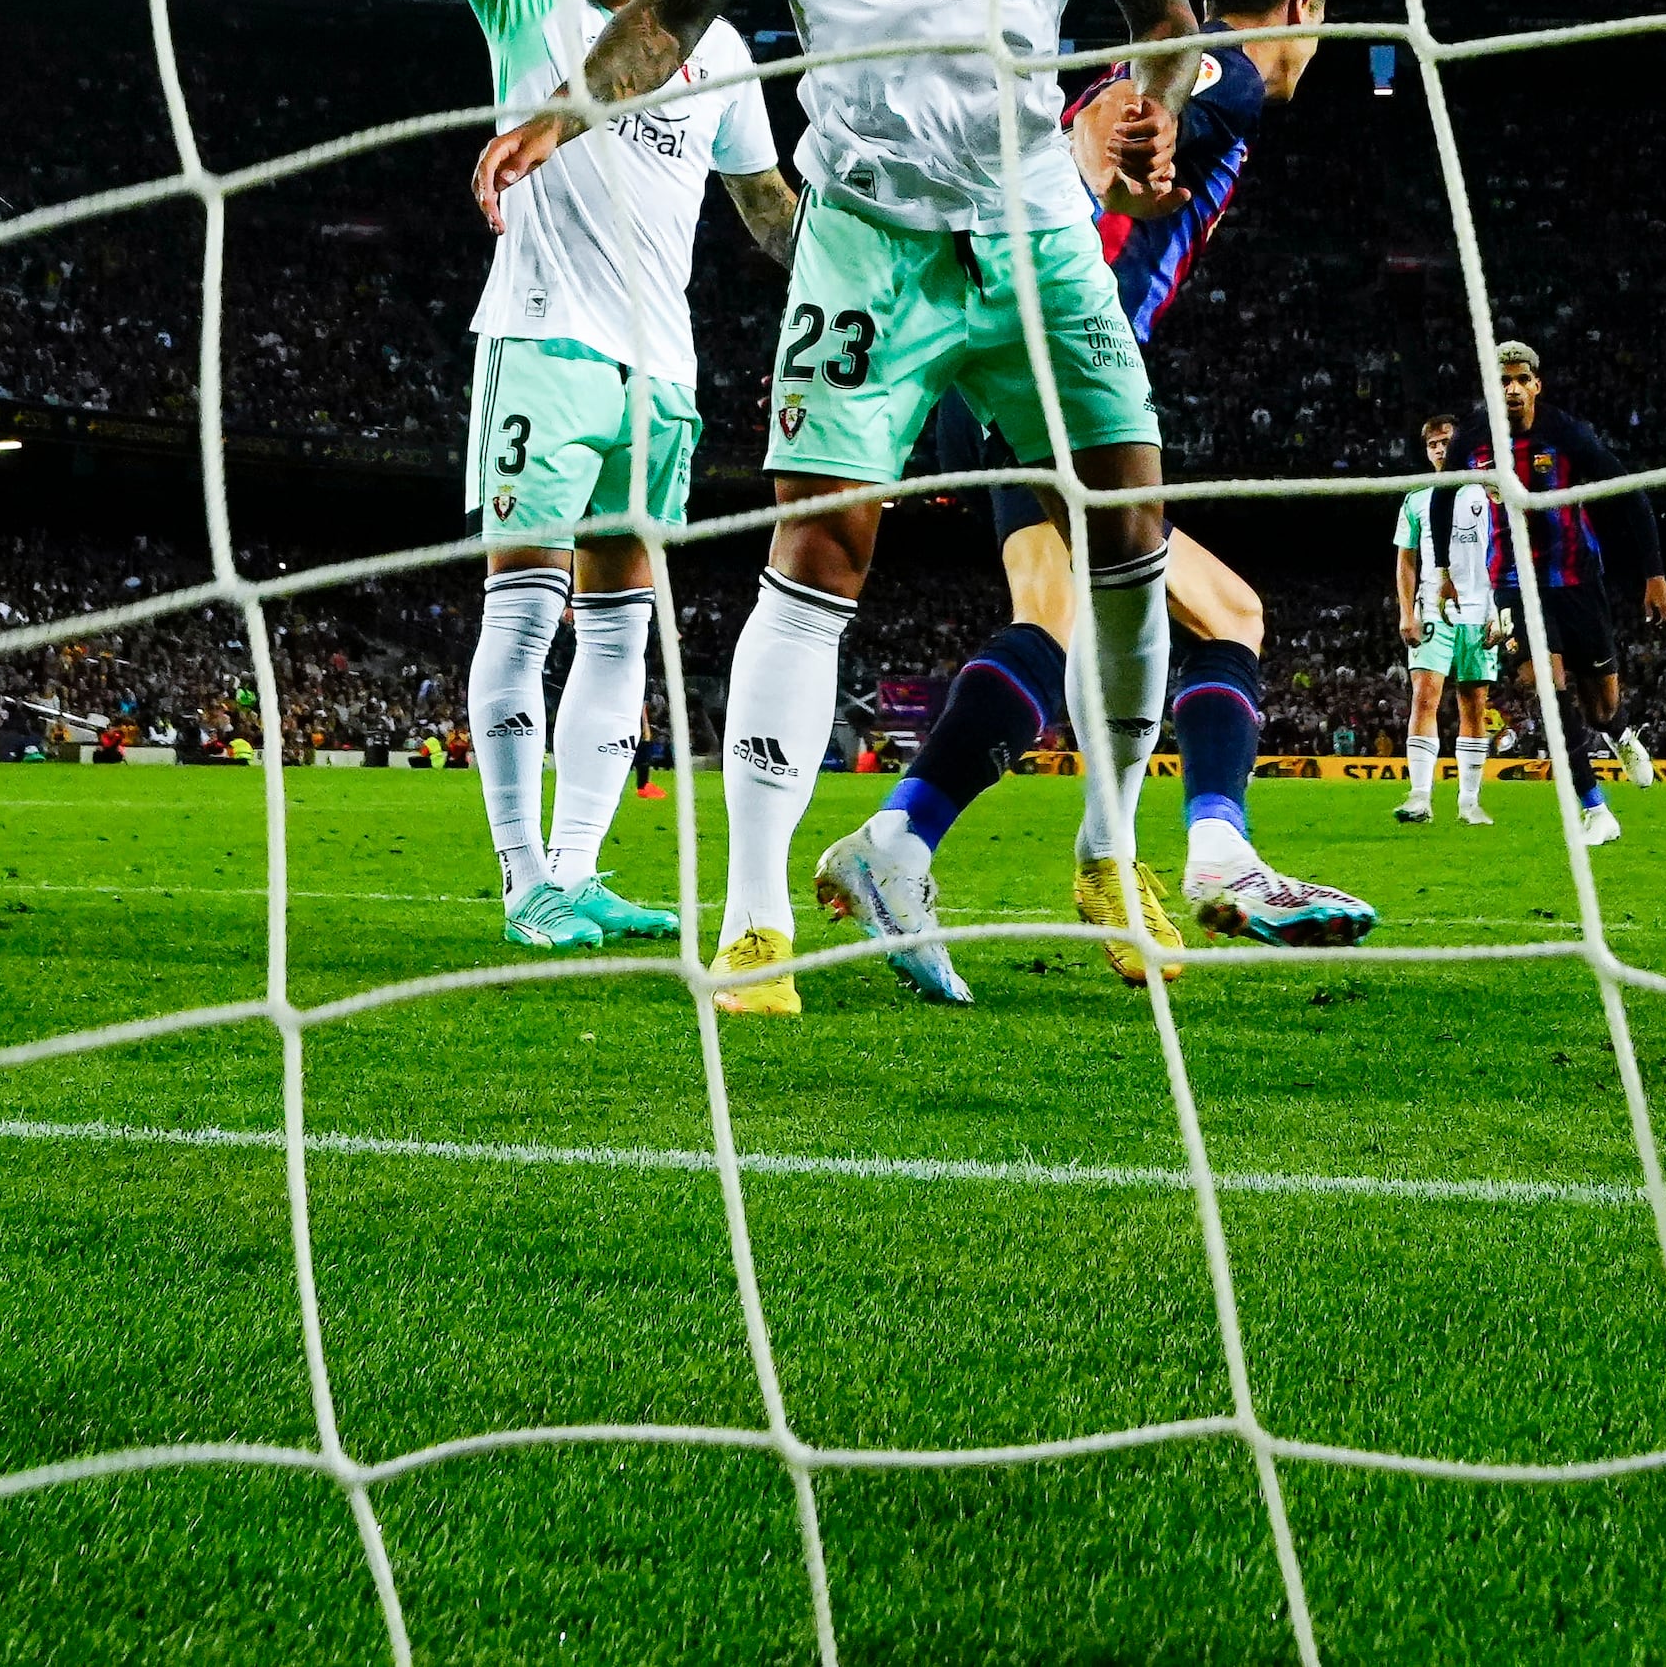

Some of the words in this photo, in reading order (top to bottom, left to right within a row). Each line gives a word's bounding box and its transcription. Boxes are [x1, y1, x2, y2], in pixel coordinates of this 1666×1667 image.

[780, 303, 876, 389] 23
[1093, 351, 1112, 367] de
[495, 414, 531, 476] 3
[732, 744, 799, 777] adidas
